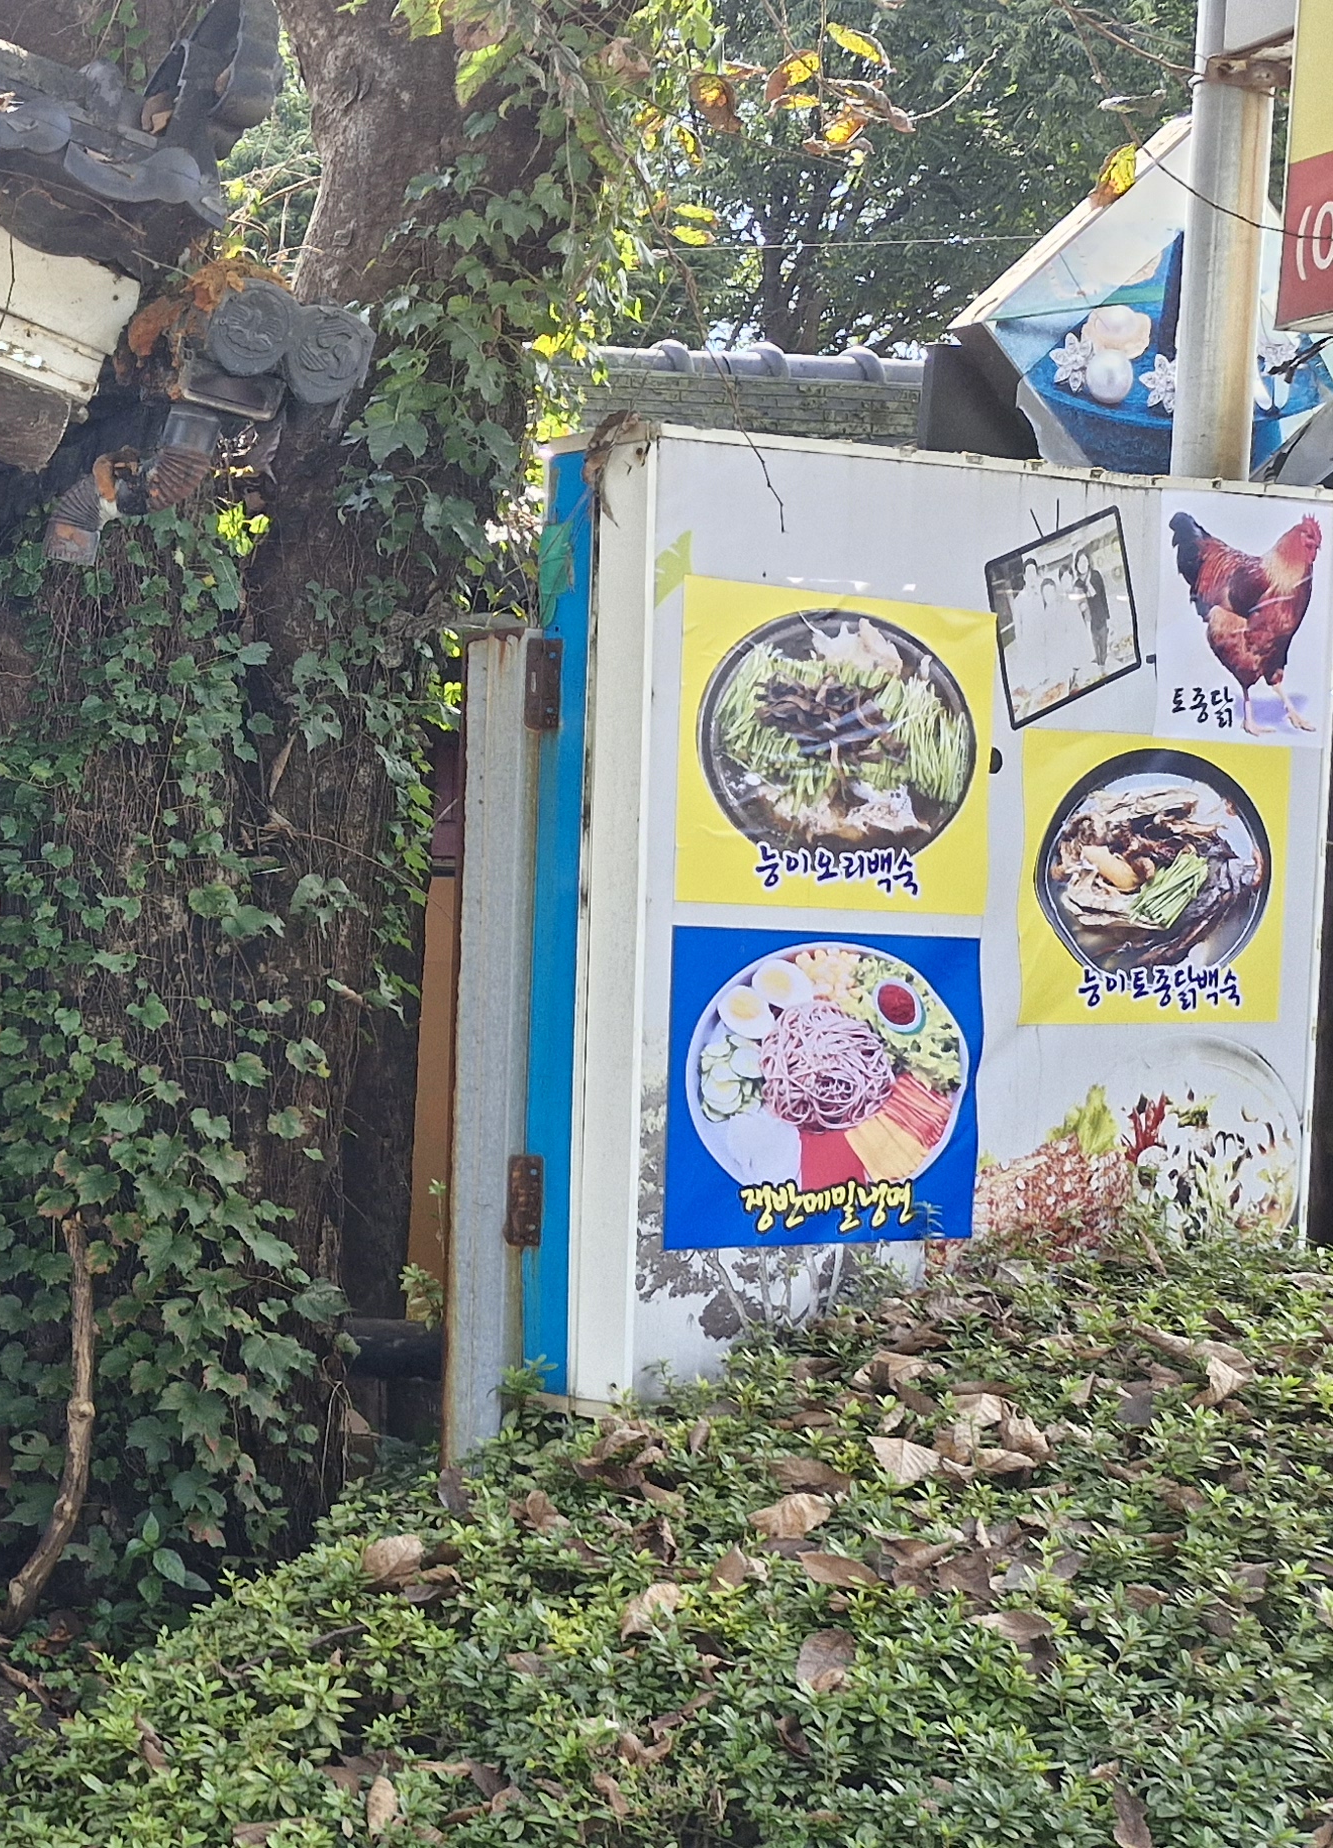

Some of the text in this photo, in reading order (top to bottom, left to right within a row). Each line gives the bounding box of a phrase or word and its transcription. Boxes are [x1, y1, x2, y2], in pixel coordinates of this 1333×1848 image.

[1172, 686, 1233, 728] 토종닭
[755, 844, 919, 895] 능이오리백숙
[1078, 965, 1241, 1010] 능이토종닭백숙
[740, 1180, 914, 1233] 쟁반메밀냉면
